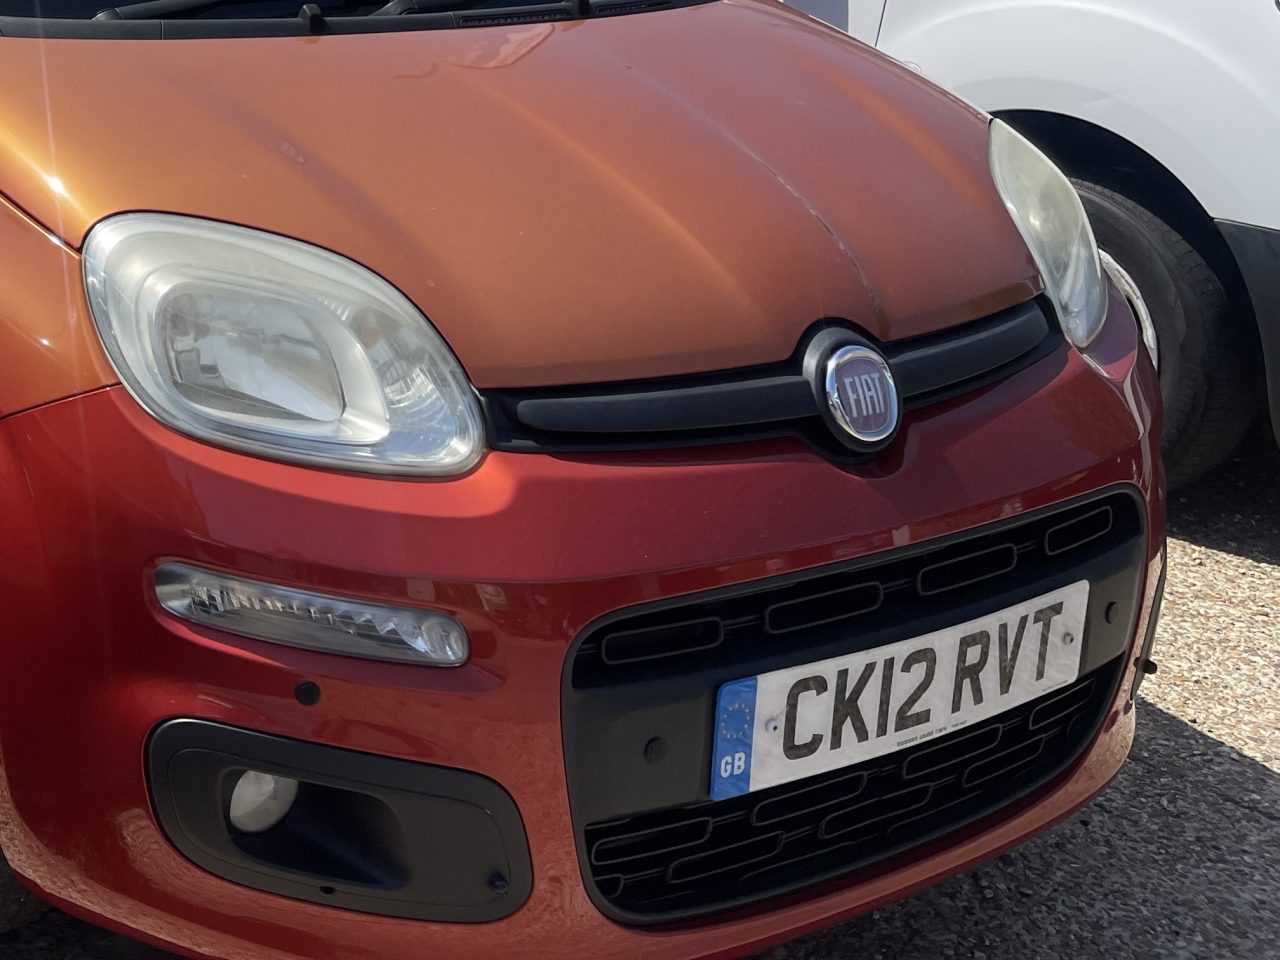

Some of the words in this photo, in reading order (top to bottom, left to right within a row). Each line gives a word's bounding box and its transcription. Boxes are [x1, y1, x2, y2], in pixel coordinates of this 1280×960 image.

[844, 372, 885, 418] FIAT
[782, 646, 937, 761] CK12
[951, 600, 1064, 715] RVT
[720, 751, 746, 778] GB
